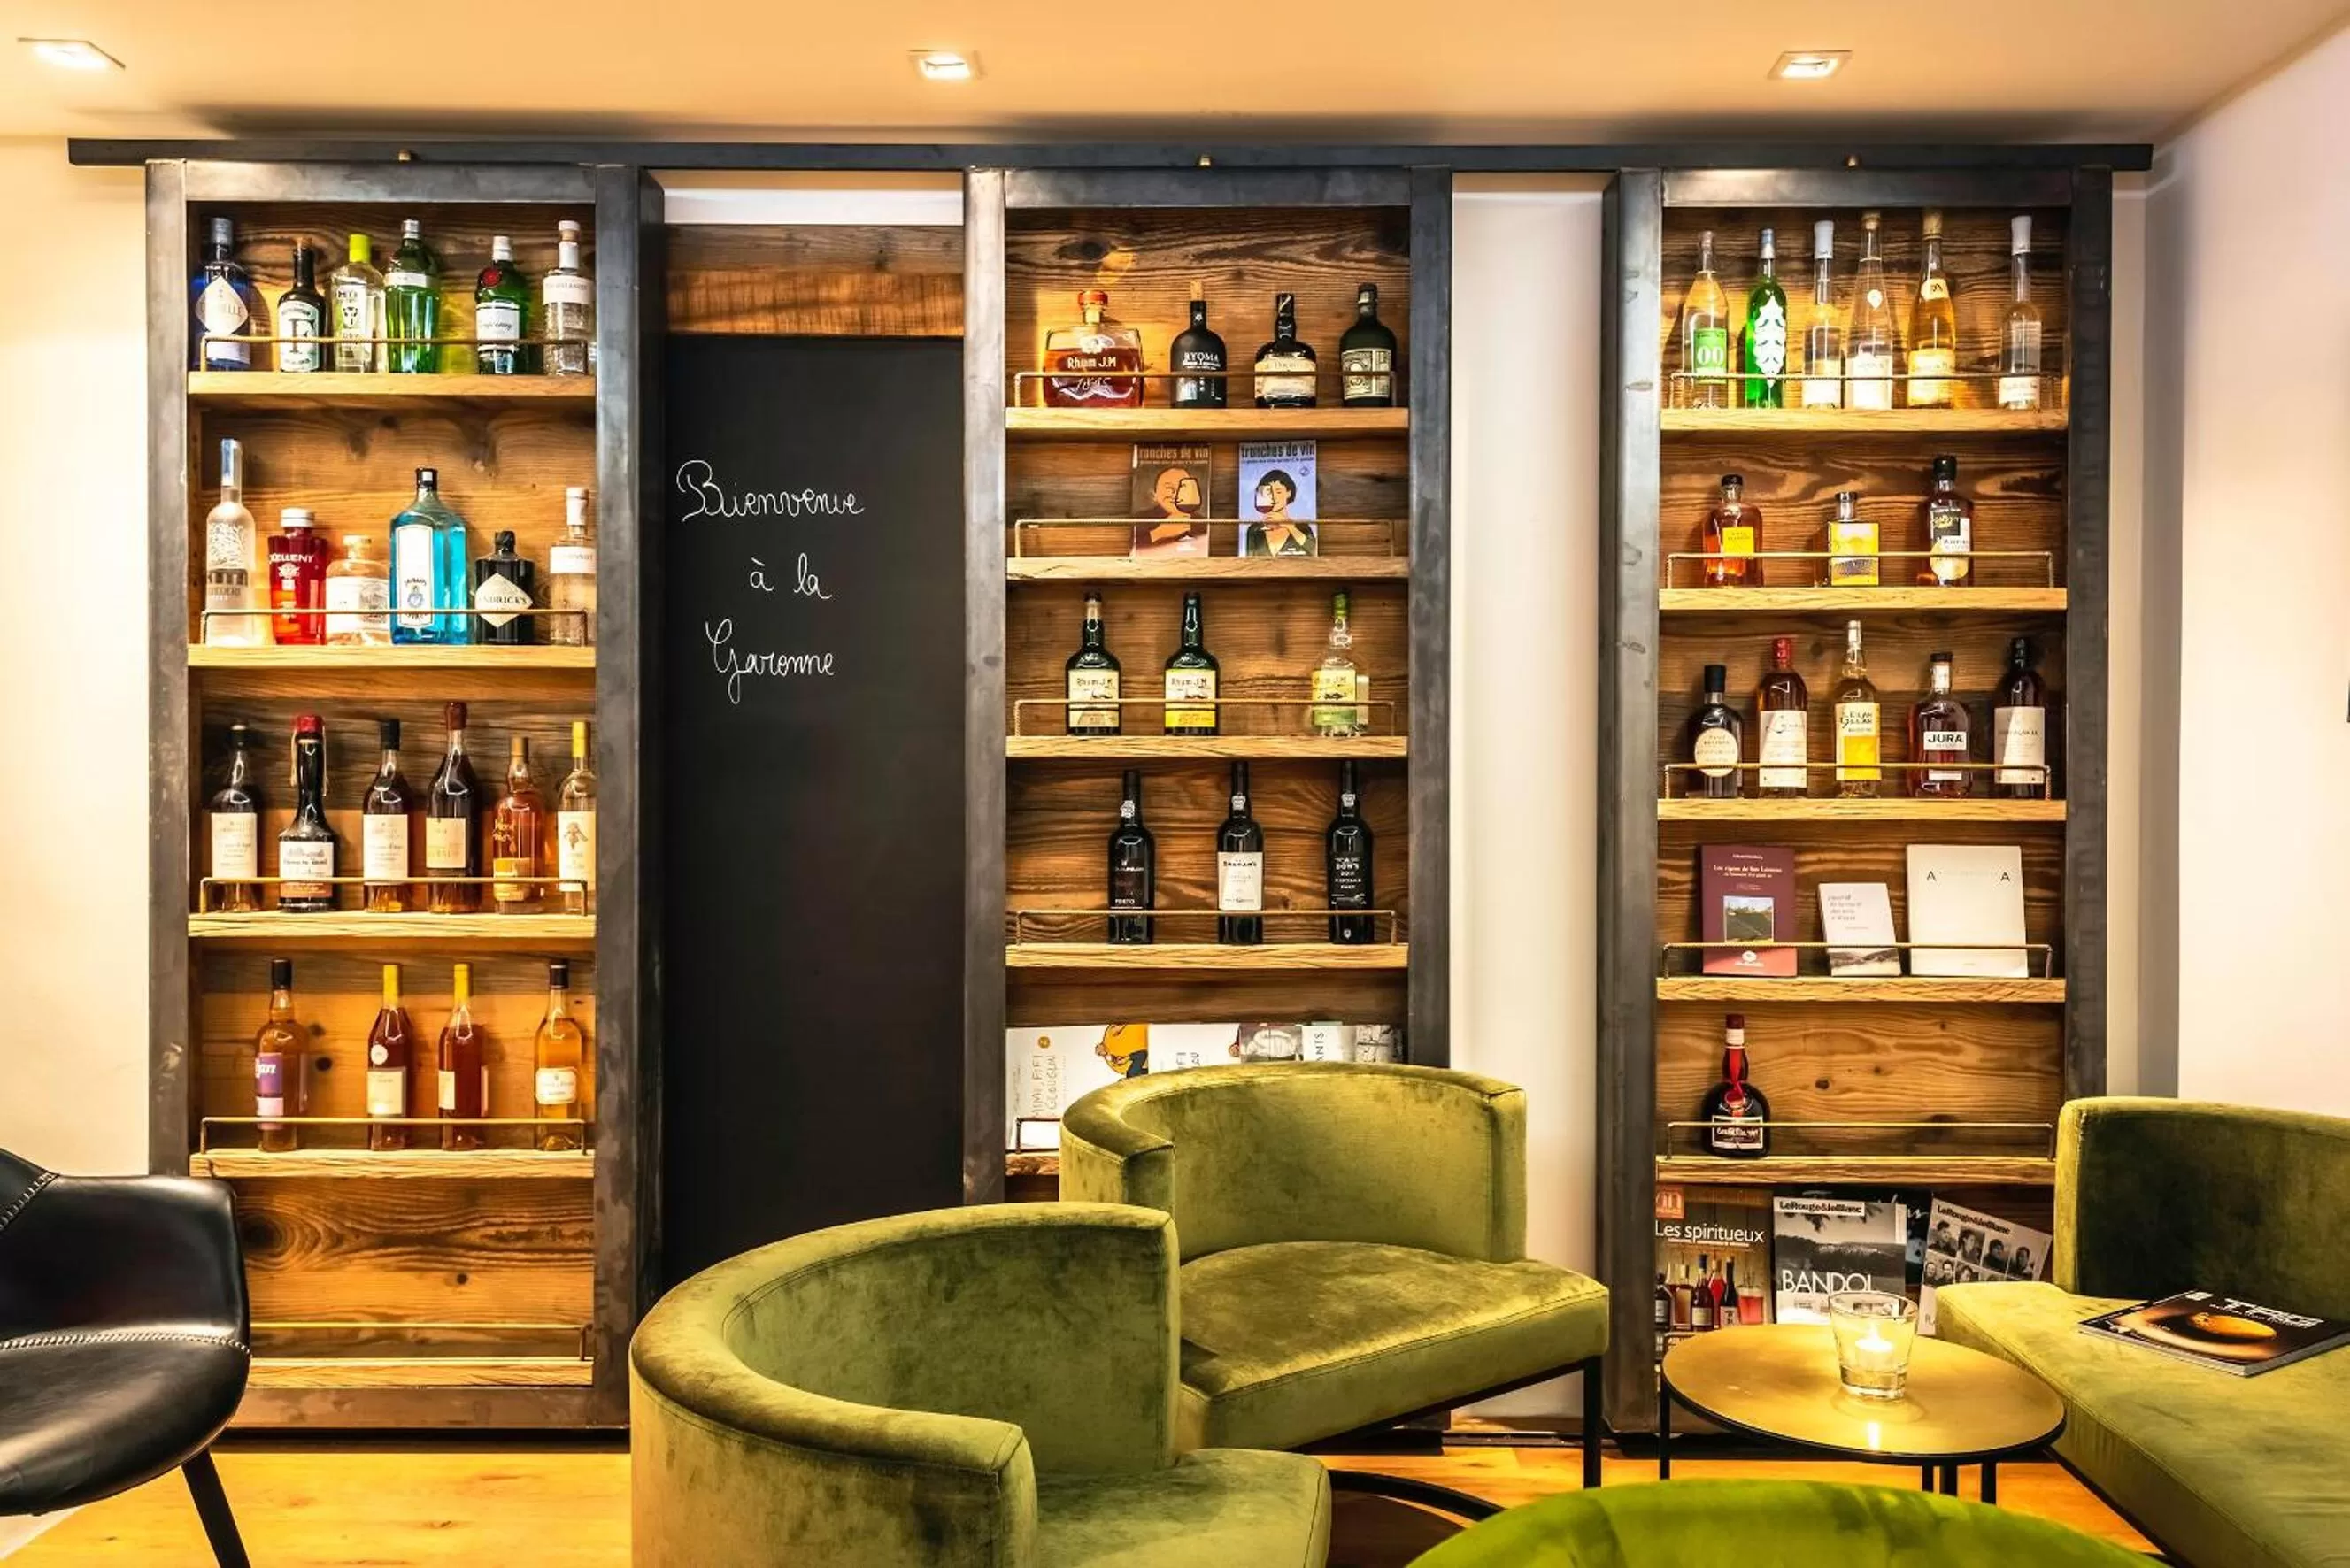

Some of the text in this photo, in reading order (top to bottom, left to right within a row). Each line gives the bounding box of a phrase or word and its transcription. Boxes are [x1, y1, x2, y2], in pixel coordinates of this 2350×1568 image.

[1067, 357, 1097, 368] Rhum
[676, 459, 866, 522] Bienvenue
[750, 552, 833, 599] à la
[705, 618, 836, 704] Garonne
[1927, 734, 1963, 743] JURA
[1999, 871, 2011, 882] A
[1655, 1220, 1682, 1237] Les
[1684, 1223, 1765, 1243] spiritueux
